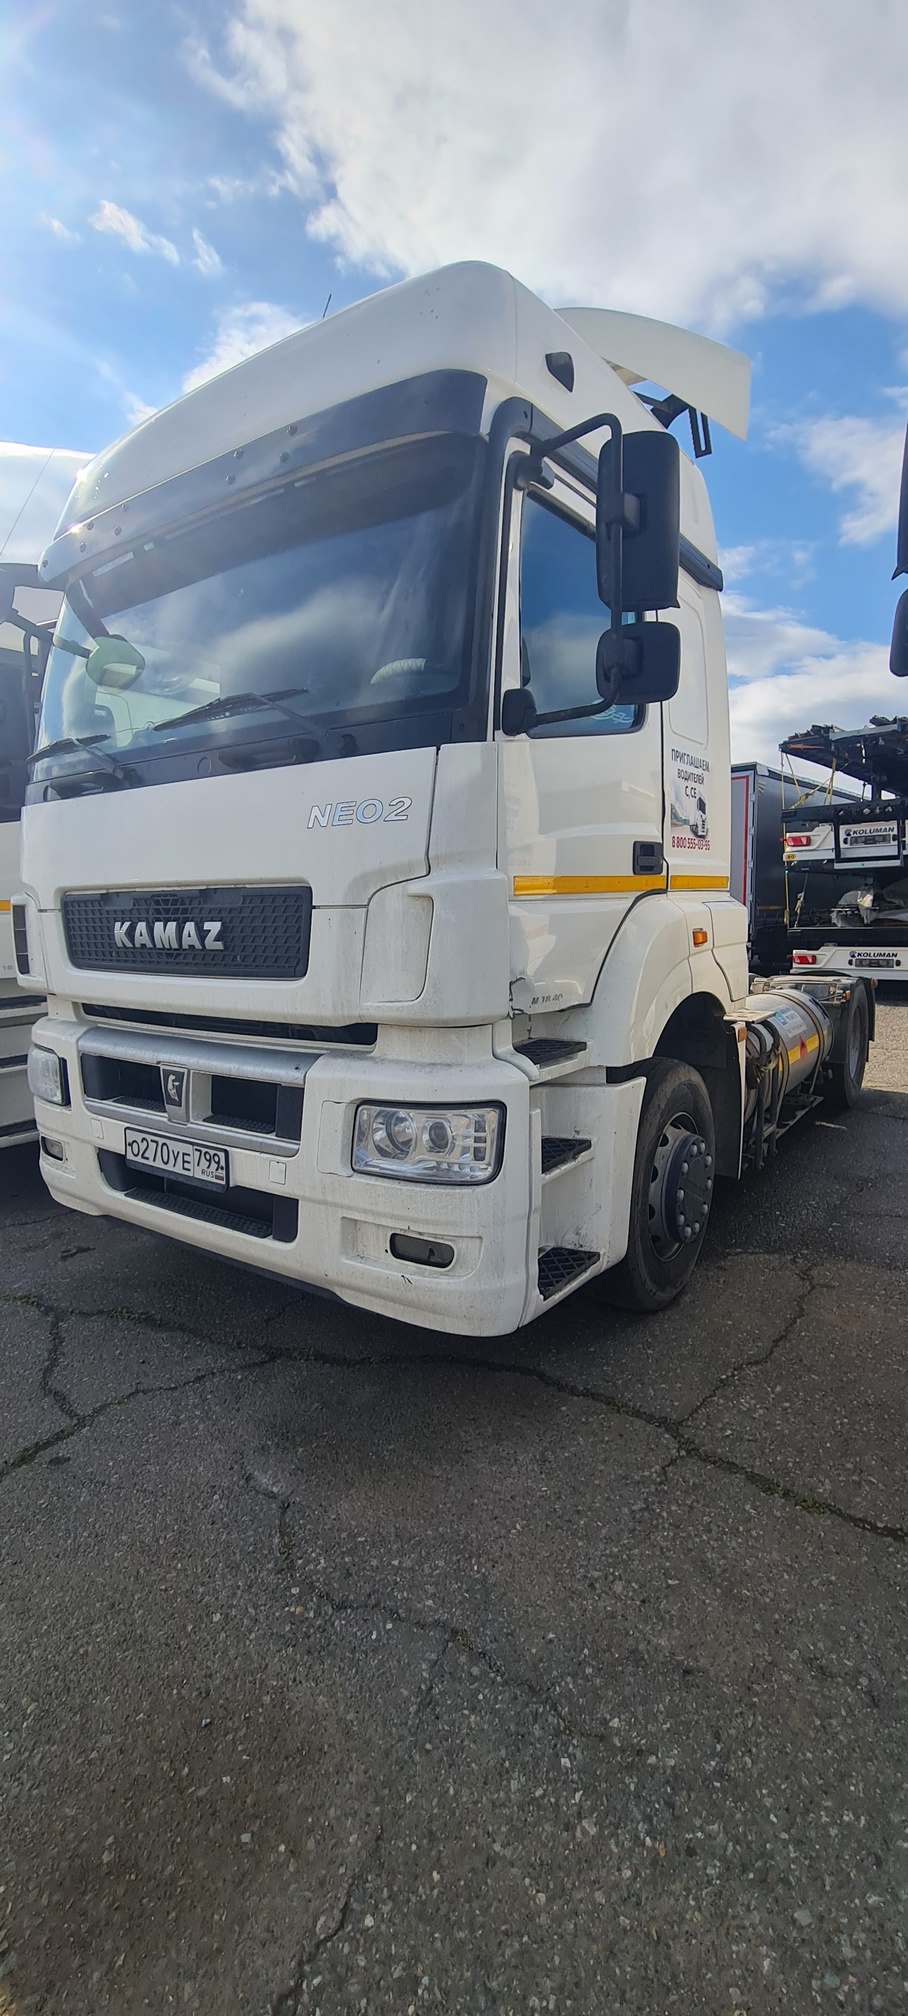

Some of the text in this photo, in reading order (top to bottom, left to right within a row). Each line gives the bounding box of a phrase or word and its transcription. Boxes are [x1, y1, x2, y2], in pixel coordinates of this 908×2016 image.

[671, 748, 710, 772] ПРИГЛАШАЕМ
[677, 768, 705, 785] ВОДИТЕЛЕЙ
[306, 796, 413, 829] NEO2
[852, 826, 895, 836] KOLUMAN
[671, 836, 676, 848] 8
[676, 836, 687, 849] 800
[114, 921, 224, 950] KAMAZ
[856, 951, 898, 959] KOLUMAN
[194, 1148, 221, 1172] 799
[201, 1168, 215, 1179] RUS
